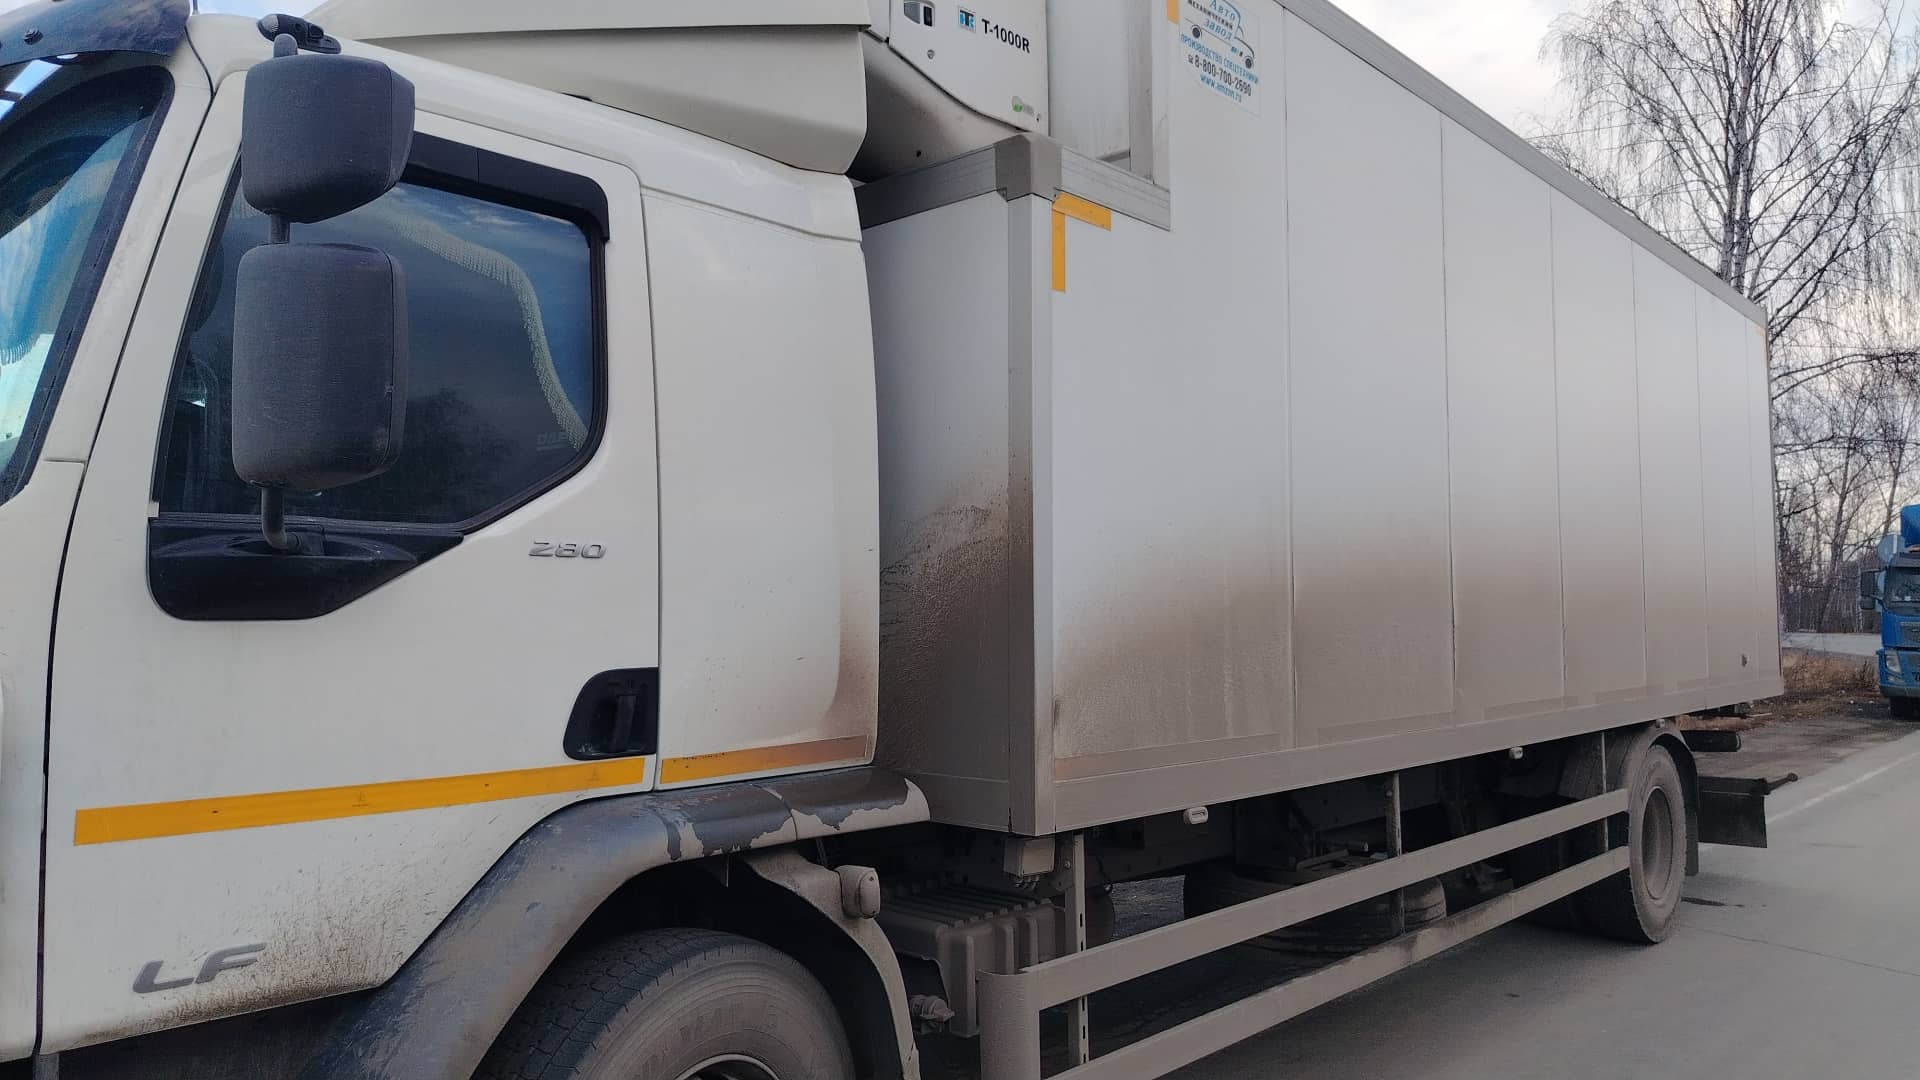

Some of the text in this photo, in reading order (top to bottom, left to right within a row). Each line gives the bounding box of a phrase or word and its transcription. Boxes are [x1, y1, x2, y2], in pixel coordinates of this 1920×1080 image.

[1208, 0, 1236, 21] Авто
[981, 18, 1030, 53] T-1000R
[1181, 33, 1222, 65] ПРОИЗВОДСТВО
[529, 540, 606, 559] 280
[132, 943, 267, 993] LF
